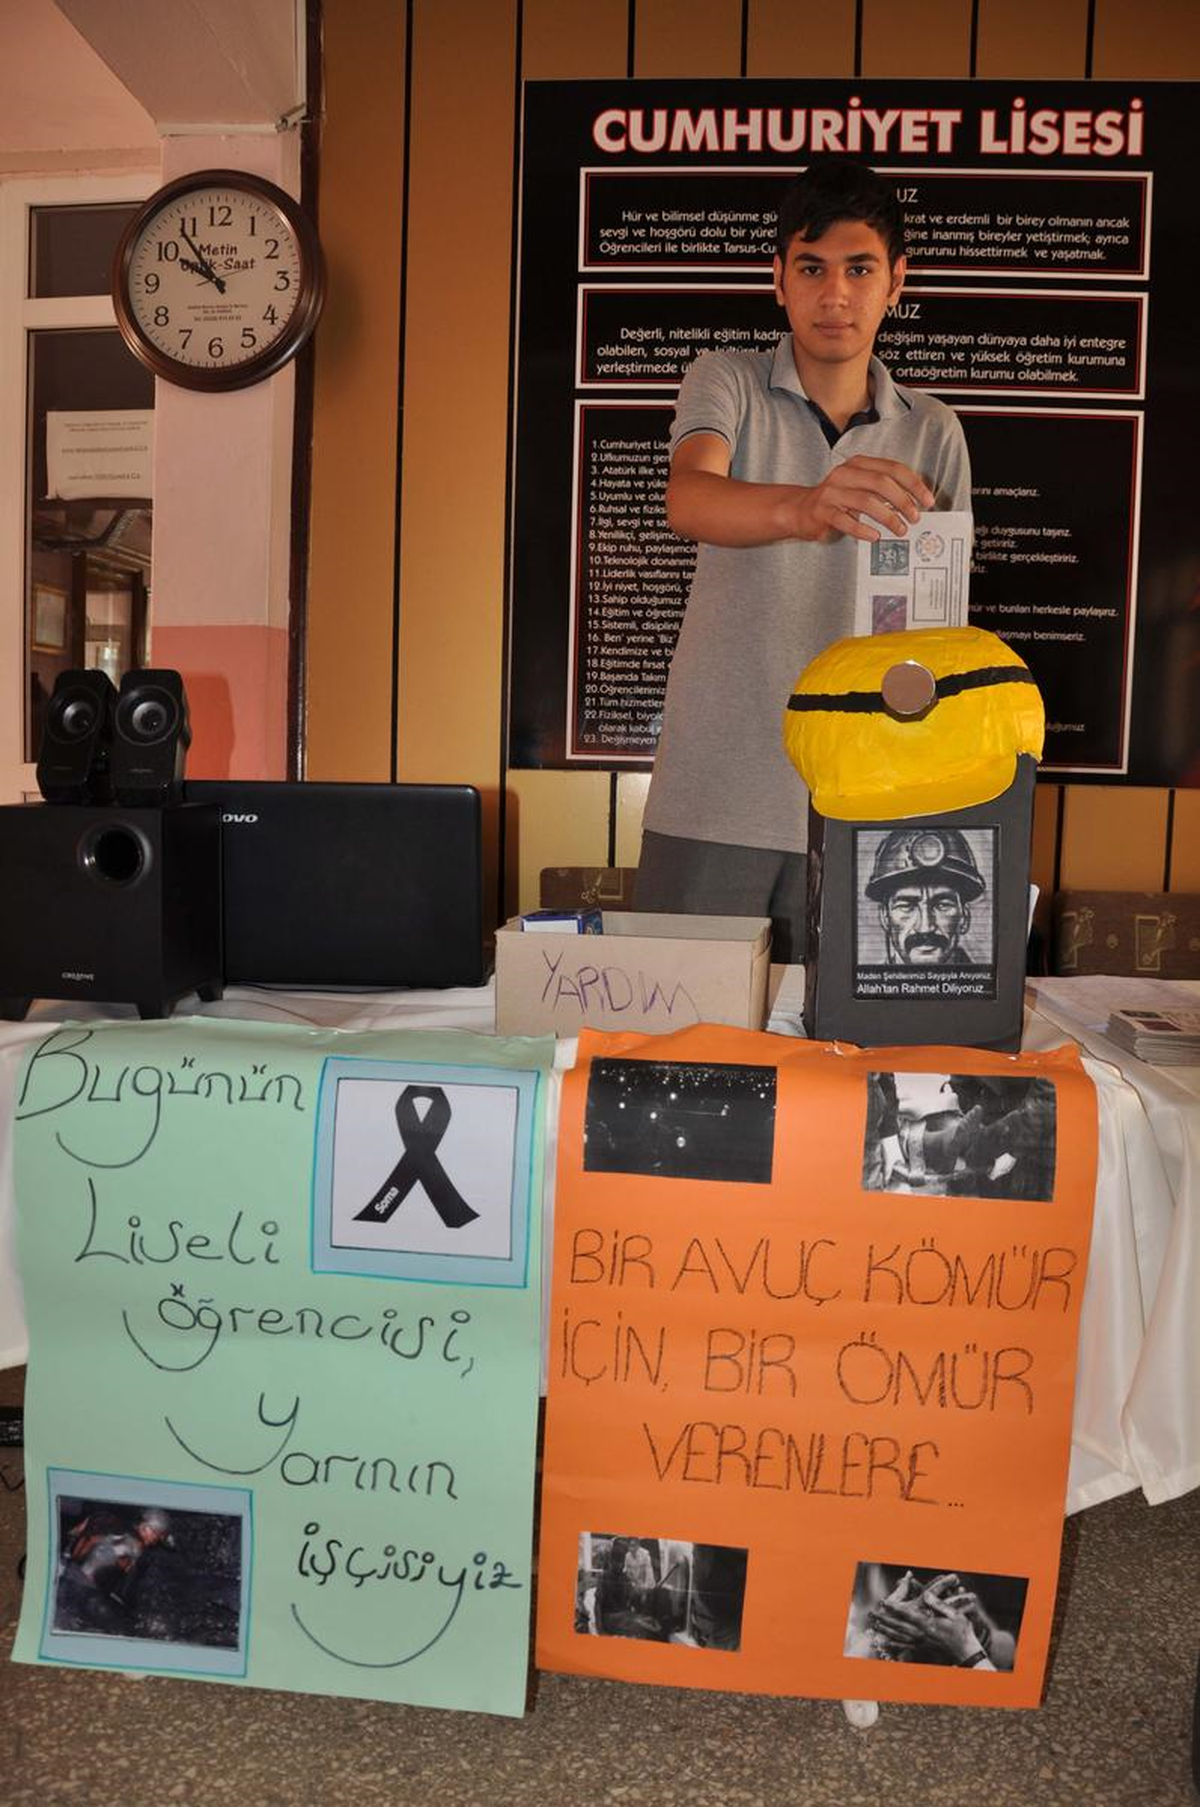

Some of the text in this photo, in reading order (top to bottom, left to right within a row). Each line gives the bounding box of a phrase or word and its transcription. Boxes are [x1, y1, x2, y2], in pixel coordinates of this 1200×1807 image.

[592, 97, 1145, 156] CUMHURİYET LİSESİ
[208, 206, 233, 227] 12
[622, 210, 778, 225] Hür ve bilimsel düşünme gü
[904, 213, 1130, 229] krat ve erdemli bir birey olmanın ancak
[180, 217, 198, 237] 11
[249, 216, 256, 236] 1
[599, 227, 629, 240] sevgi
[632, 228, 647, 238] ve
[650, 226, 697, 240] hoşgörü
[700, 227, 727, 238] dolu
[730, 227, 746, 238] bir
[903, 230, 928, 242] ğine
[932, 230, 975, 243] inanmış
[978, 230, 1021, 244] bireyler
[1095, 234, 1129, 246] ayrıca
[156, 240, 179, 262] 10
[199, 243, 238, 256] Metin
[264, 239, 280, 260] 2
[665, 242, 678, 253] ile
[681, 242, 721, 254] birlikte
[724, 242, 778, 254] Tarsus-Cu
[905, 247, 956, 259] gururunu
[959, 246, 1027, 259] hissettirmek
[1034, 249, 1048, 259] ve
[144, 273, 160, 294] 9
[274, 270, 290, 292] 3
[154, 305, 170, 327] 8
[262, 304, 279, 326] 4
[178, 329, 193, 350] 7
[240, 328, 257, 349] 5
[620, 327, 787, 343] Değerli, nitelikli eğitim kadro
[877, 331, 1127, 351] değişim yaşayan dünyaya daha iyi entegre
[208, 337, 224, 359] 6
[597, 344, 648, 358] olabilen,
[653, 345, 690, 359] sosyal
[878, 349, 1126, 367] söz ettiren ve yüksek öğretim kurumuna
[596, 361, 677, 377] yerleştirmede
[896, 367, 967, 382] ortaöğretim
[971, 368, 1015, 381] kurumu
[602, 465, 637, 475] Atatürk
[633, 481, 646, 489] ve
[629, 506, 641, 515] ve
[616, 518, 640, 529] sevgi
[642, 519, 655, 527] ve
[991, 525, 1041, 538] duygusunu
[632, 610, 643, 618] ve
[1033, 605, 1072, 616] herkesle
[626, 634, 655, 644] yerine
[651, 648, 662, 656] ve
[901, 982, 940, 994] Rahmet
[374, 1186, 400, 1214] Soma
[570, 1228, 1079, 1314] BİR AVUÇ KÖMÜR
[704, 1326, 797, 1398] BİR
[836, 1330, 1036, 1414] ÖMÜR
